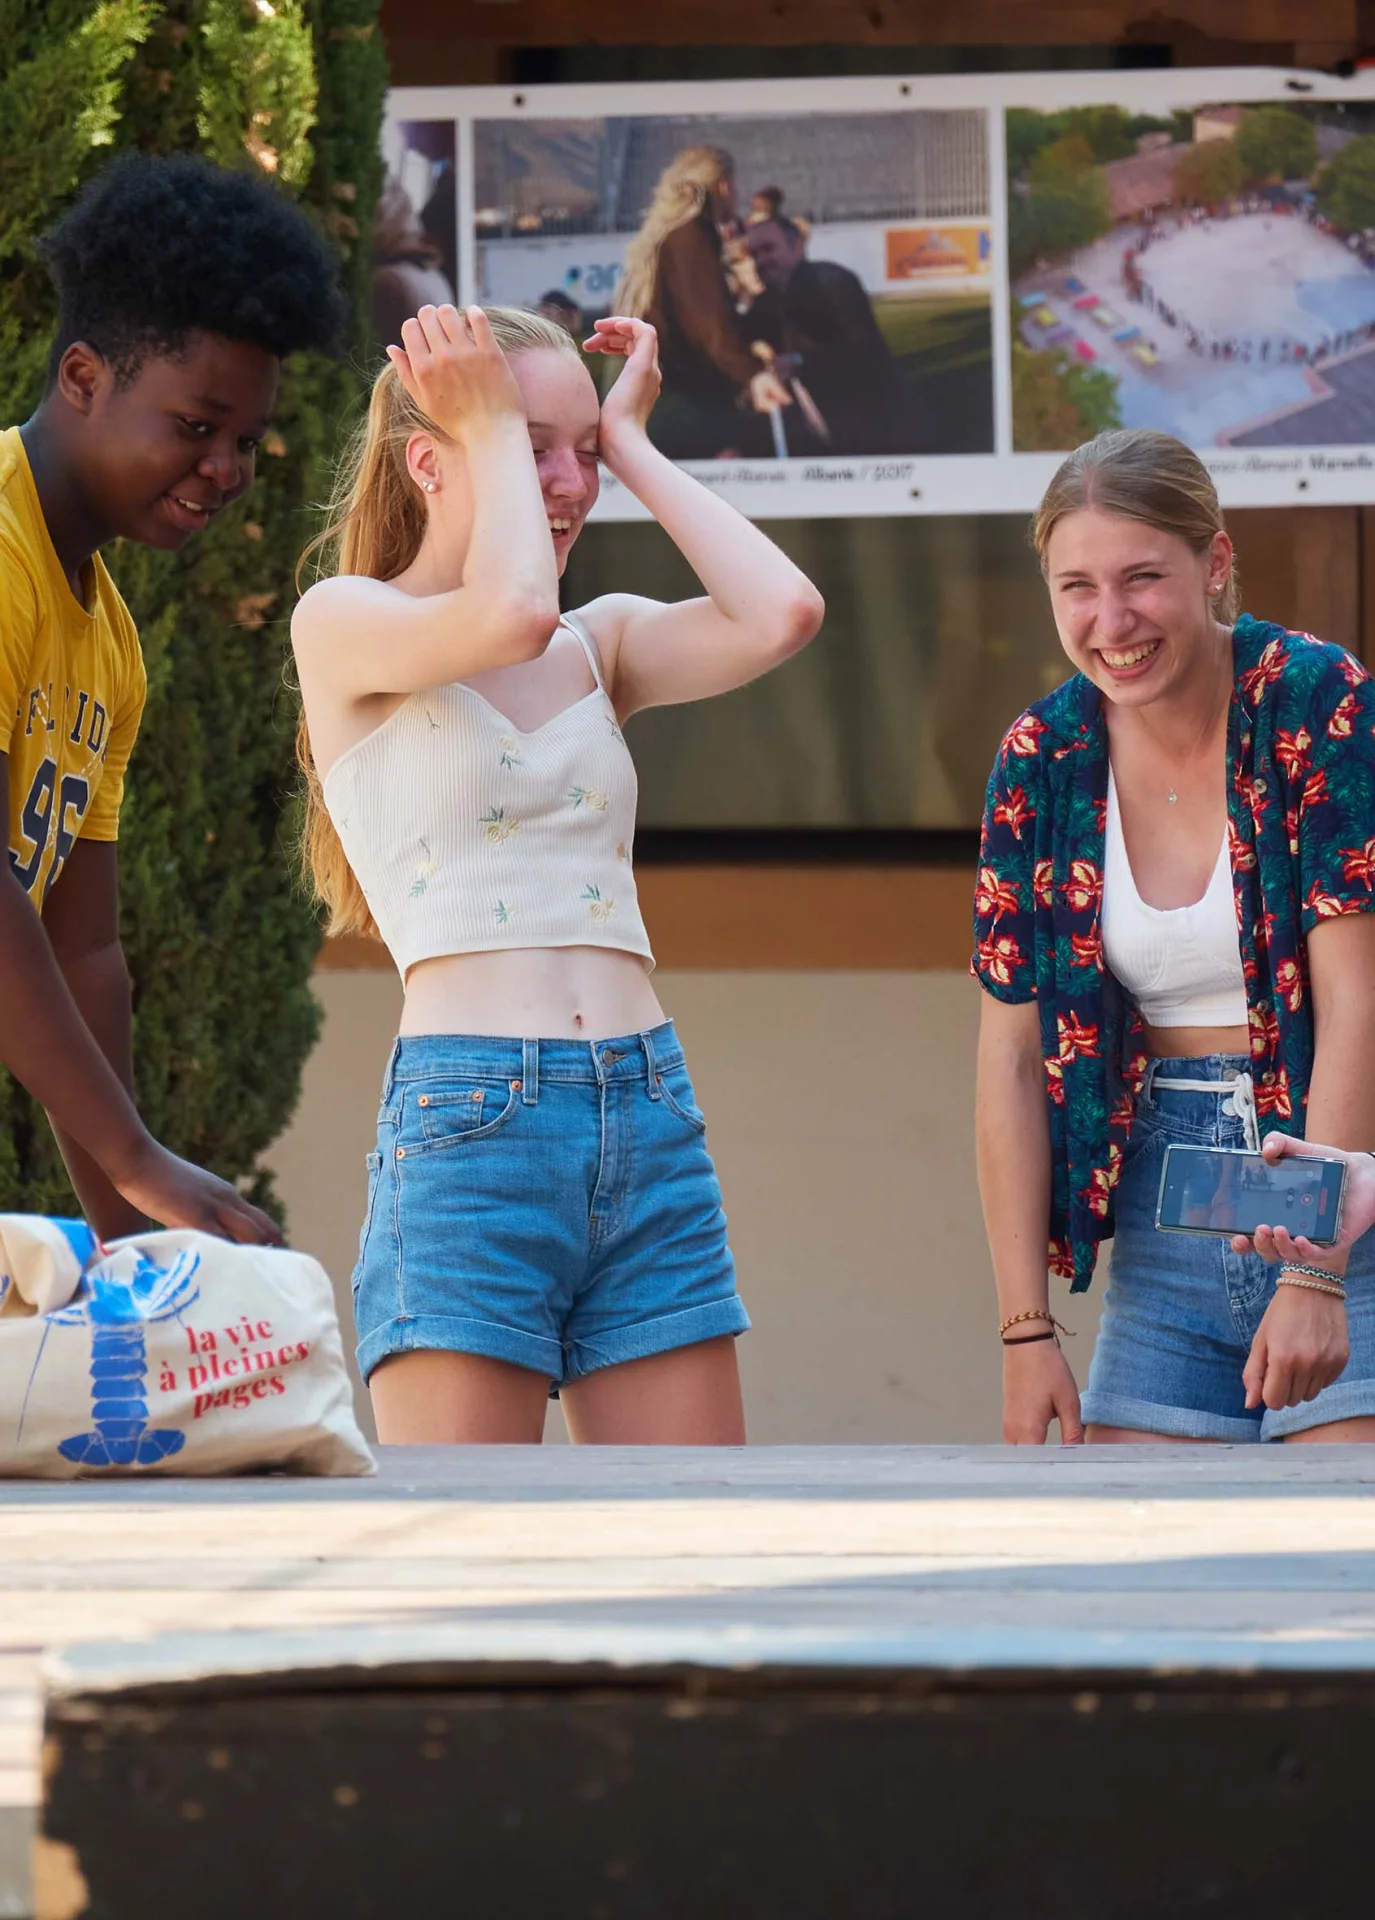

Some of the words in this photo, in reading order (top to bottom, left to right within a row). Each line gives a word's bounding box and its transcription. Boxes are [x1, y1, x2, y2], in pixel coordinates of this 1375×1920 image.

[185, 1326, 217, 1354] la
[223, 1316, 274, 1346] vie
[159, 1360, 177, 1392] à
[187, 1340, 311, 1390] pleines
[193, 1374, 286, 1419] pages
